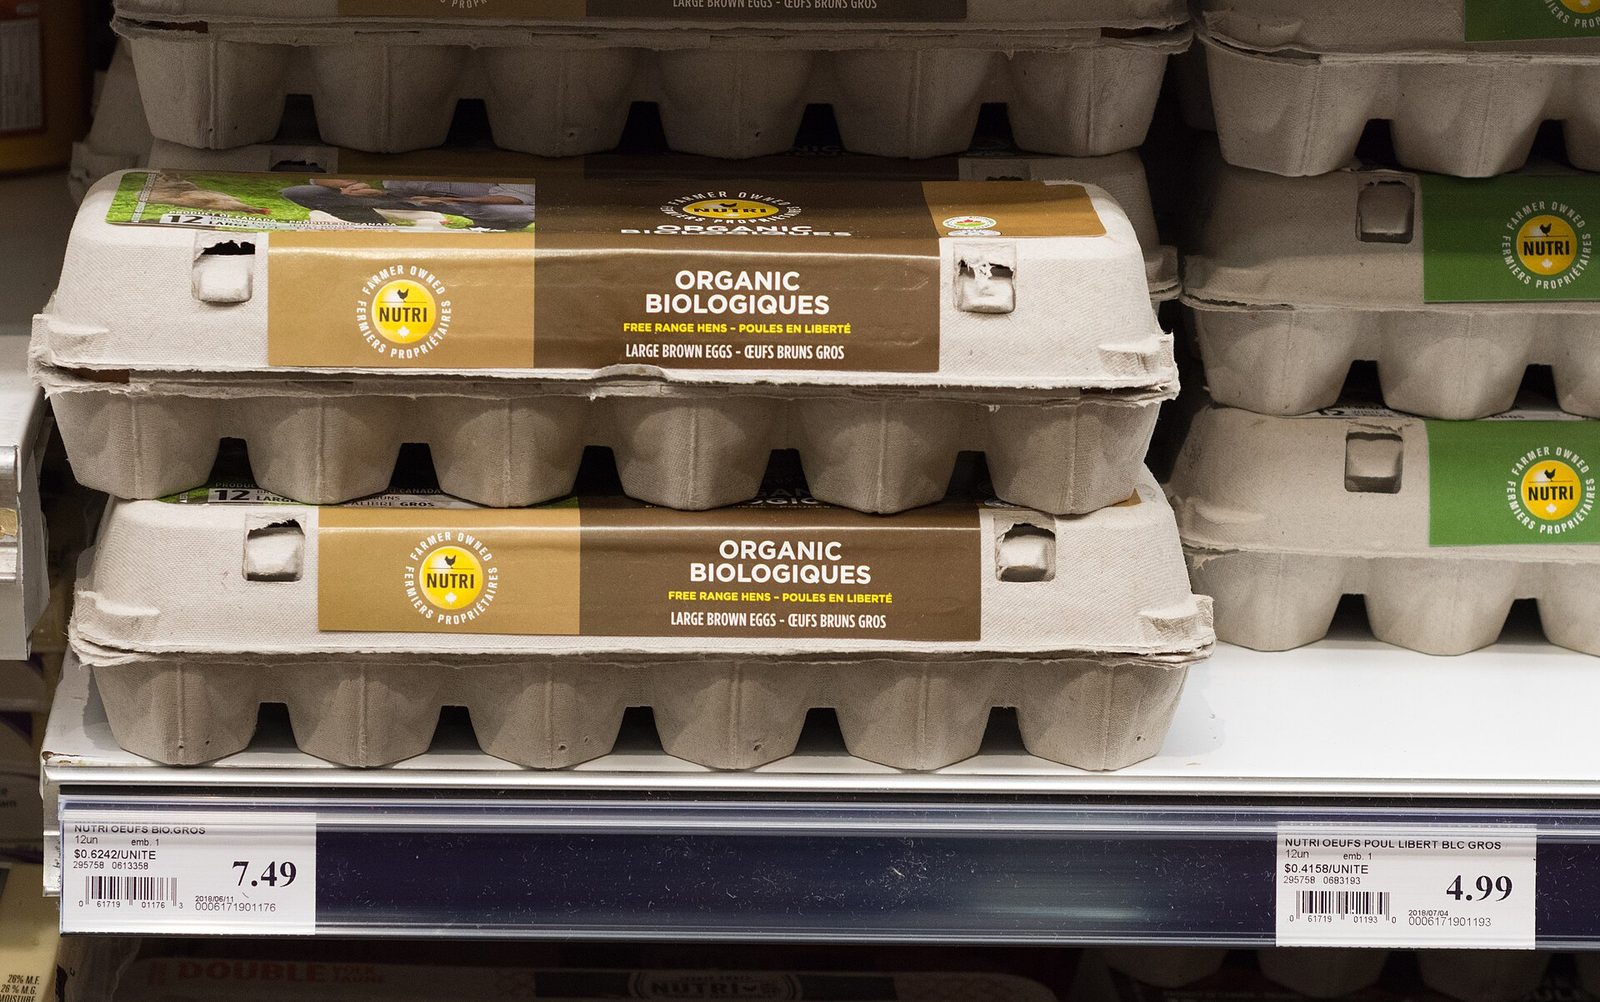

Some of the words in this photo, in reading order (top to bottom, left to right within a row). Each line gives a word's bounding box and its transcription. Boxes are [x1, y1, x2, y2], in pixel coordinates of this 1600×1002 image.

[673, 0, 704, 8] LARGE
[707, 0, 745, 8] BROWN
[747, 0, 773, 8] EGGS
[814, 0, 848, 9] BRUNS
[850, 0, 877, 9] GROS
[168, 215, 204, 224] 12
[1506, 201, 1545, 230] FARMER
[1551, 202, 1586, 229] OWNED
[656, 224, 812, 232] ORGANIC
[1524, 241, 1570, 256] NUTRI
[1502, 235, 1531, 284] FERMIERS
[1536, 233, 1592, 290] PROPRIÉTAIRES
[362, 265, 404, 295] FARMER
[410, 265, 446, 295] OWNED
[675, 270, 800, 291] ORGANIC
[646, 294, 830, 315] BIOLOGIQUES
[379, 307, 427, 322] NUTRI
[356, 300, 387, 353] FERMIERS
[390, 300, 452, 359] PROPRIÉTAIRES
[623, 323, 652, 332] FREE
[655, 323, 694, 333] RANGE
[698, 323, 727, 333] HENS
[739, 324, 784, 334] POULES
[786, 324, 801, 334] EN
[804, 322, 851, 334] LIBERTÉ
[626, 344, 659, 358] LARGE
[662, 344, 703, 358] BROWN
[706, 345, 732, 359] EGGS
[744, 345, 774, 359] ŒUFS
[777, 345, 812, 359] BRUNS
[816, 346, 845, 360] GROS
[1511, 446, 1550, 476] FARMER
[1555, 447, 1590, 474] OWNED
[214, 481, 257, 489] PRODUC
[215, 490, 250, 501] 12
[1528, 486, 1574, 501] NUTRI
[1506, 480, 1536, 530] FERMIERS
[1539, 478, 1596, 535] PROPRIÉTAIRES
[410, 531, 451, 561] FARMER
[457, 532, 493, 562] OWNED
[719, 540, 842, 561] ORGANIC
[427, 573, 474, 589] NUTRI
[690, 563, 871, 584] BIOLOGIQUES
[404, 566, 434, 619] FERMIERS
[437, 567, 498, 625] PROPRIÉTAIRES
[668, 591, 696, 600] FREE
[699, 591, 738, 601] RANGE
[741, 592, 771, 601] HENS
[782, 593, 826, 603] POULES
[829, 593, 844, 603] EN
[847, 592, 893, 604] LIBERTÉ
[671, 611, 704, 626] LARGE
[707, 612, 747, 626] BROWN
[750, 612, 776, 627] EGGS
[788, 613, 817, 627] ŒUFS
[820, 613, 855, 628] BRUNS
[858, 614, 887, 629] GROS
[74, 825, 108, 834] NUTRI
[110, 825, 149, 834] OEUFS
[151, 826, 206, 835] BIO.GROS
[75, 835, 98, 844] 12un
[131, 838, 152, 847] emb.
[155, 838, 159, 847] 1
[1285, 838, 1320, 847] NUTRI
[1322, 838, 1361, 848] OEUFS
[1364, 839, 1395, 849] POUL
[1398, 839, 1439, 849] LIBERT
[1441, 840, 1465, 849] BLC
[1467, 840, 1502, 850] GROS
[73, 849, 156, 860] $0.6242/UNITE
[1286, 850, 1310, 859] 12un
[1343, 852, 1365, 861] emb.
[1368, 852, 1372, 861] 1
[73, 861, 105, 870] 295758
[112, 862, 149, 870] 0613358
[1284, 863, 1369, 875] $0.4158/UNITE
[232, 861, 297, 888] 7.49
[1283, 875, 1316, 884] 295758
[1323, 876, 1361, 885] 0683193
[1446, 874, 1513, 902] 4.99
[96, 901, 121, 909] 61719
[141, 901, 166, 909] 01176
[178, 902, 184, 910] 3
[195, 902, 276, 912] 0006171901176
[1289, 915, 1294, 923] 0
[1307, 915, 1333, 923] 61719
[1353, 915, 1378, 924] 01193
[1391, 916, 1397, 924] 0
[1408, 916, 1492, 927] 0006171901193
[178, 961, 325, 983] DOUBLE
